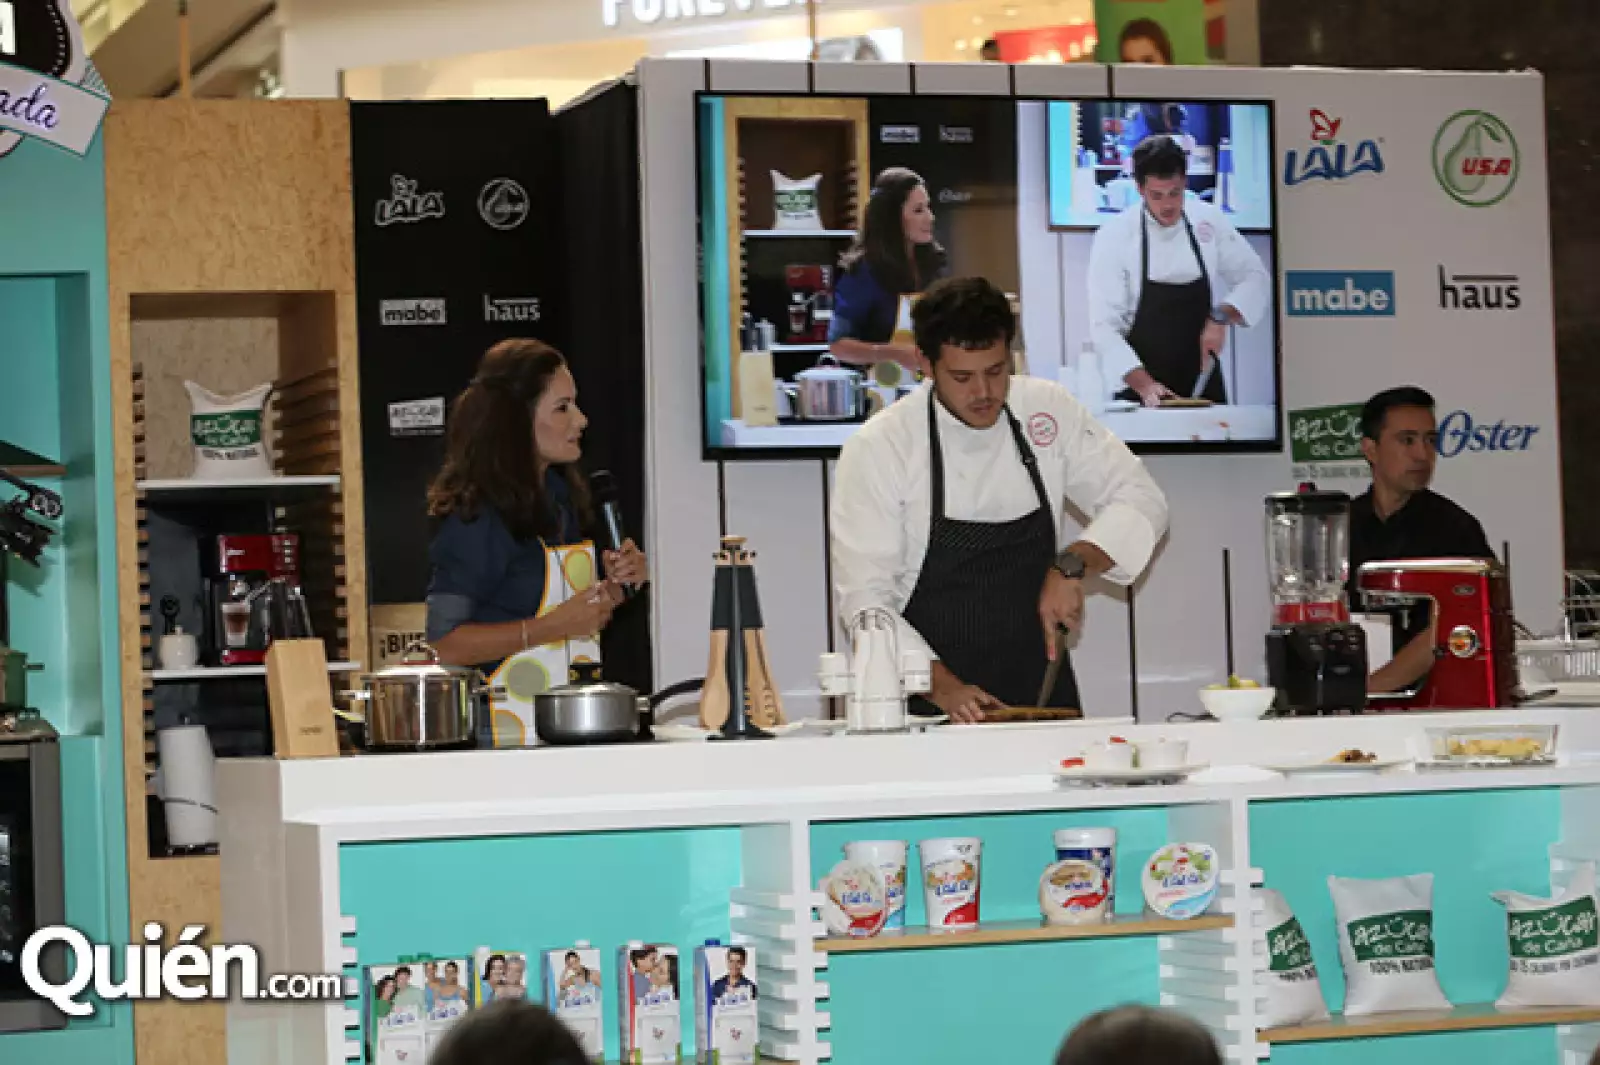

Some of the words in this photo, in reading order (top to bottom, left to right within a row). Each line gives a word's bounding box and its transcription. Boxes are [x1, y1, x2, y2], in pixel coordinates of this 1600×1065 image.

[1284, 139, 1384, 185] LALA
[1462, 157, 1511, 176] USA
[1292, 278, 1390, 311] mabe
[1438, 264, 1521, 310] haus
[384, 305, 442, 323] mabe
[485, 294, 541, 322] haus
[1436, 410, 1538, 458] Oster
